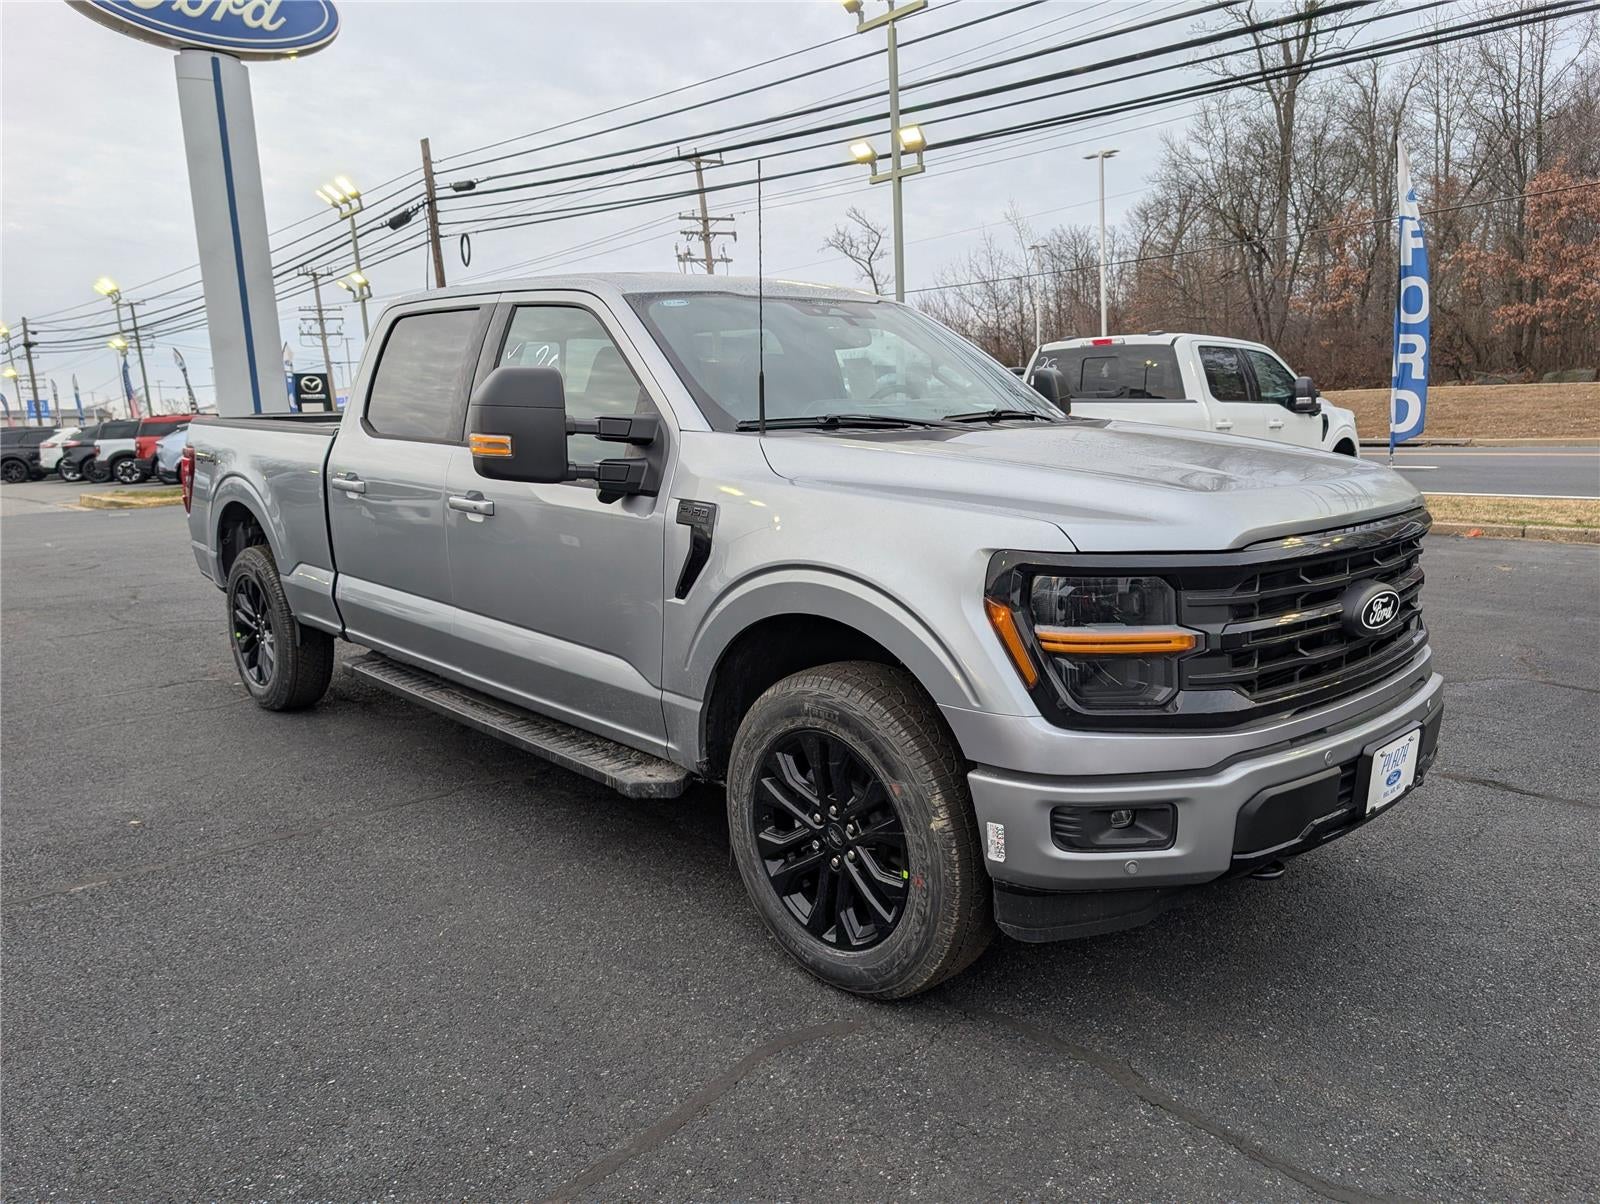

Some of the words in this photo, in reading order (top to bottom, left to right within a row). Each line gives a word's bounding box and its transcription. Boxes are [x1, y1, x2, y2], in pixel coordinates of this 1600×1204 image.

[1391, 218, 1430, 434] FORD
[1369, 596, 1394, 625] Ford
[1381, 742, 1410, 776] PLAZA
